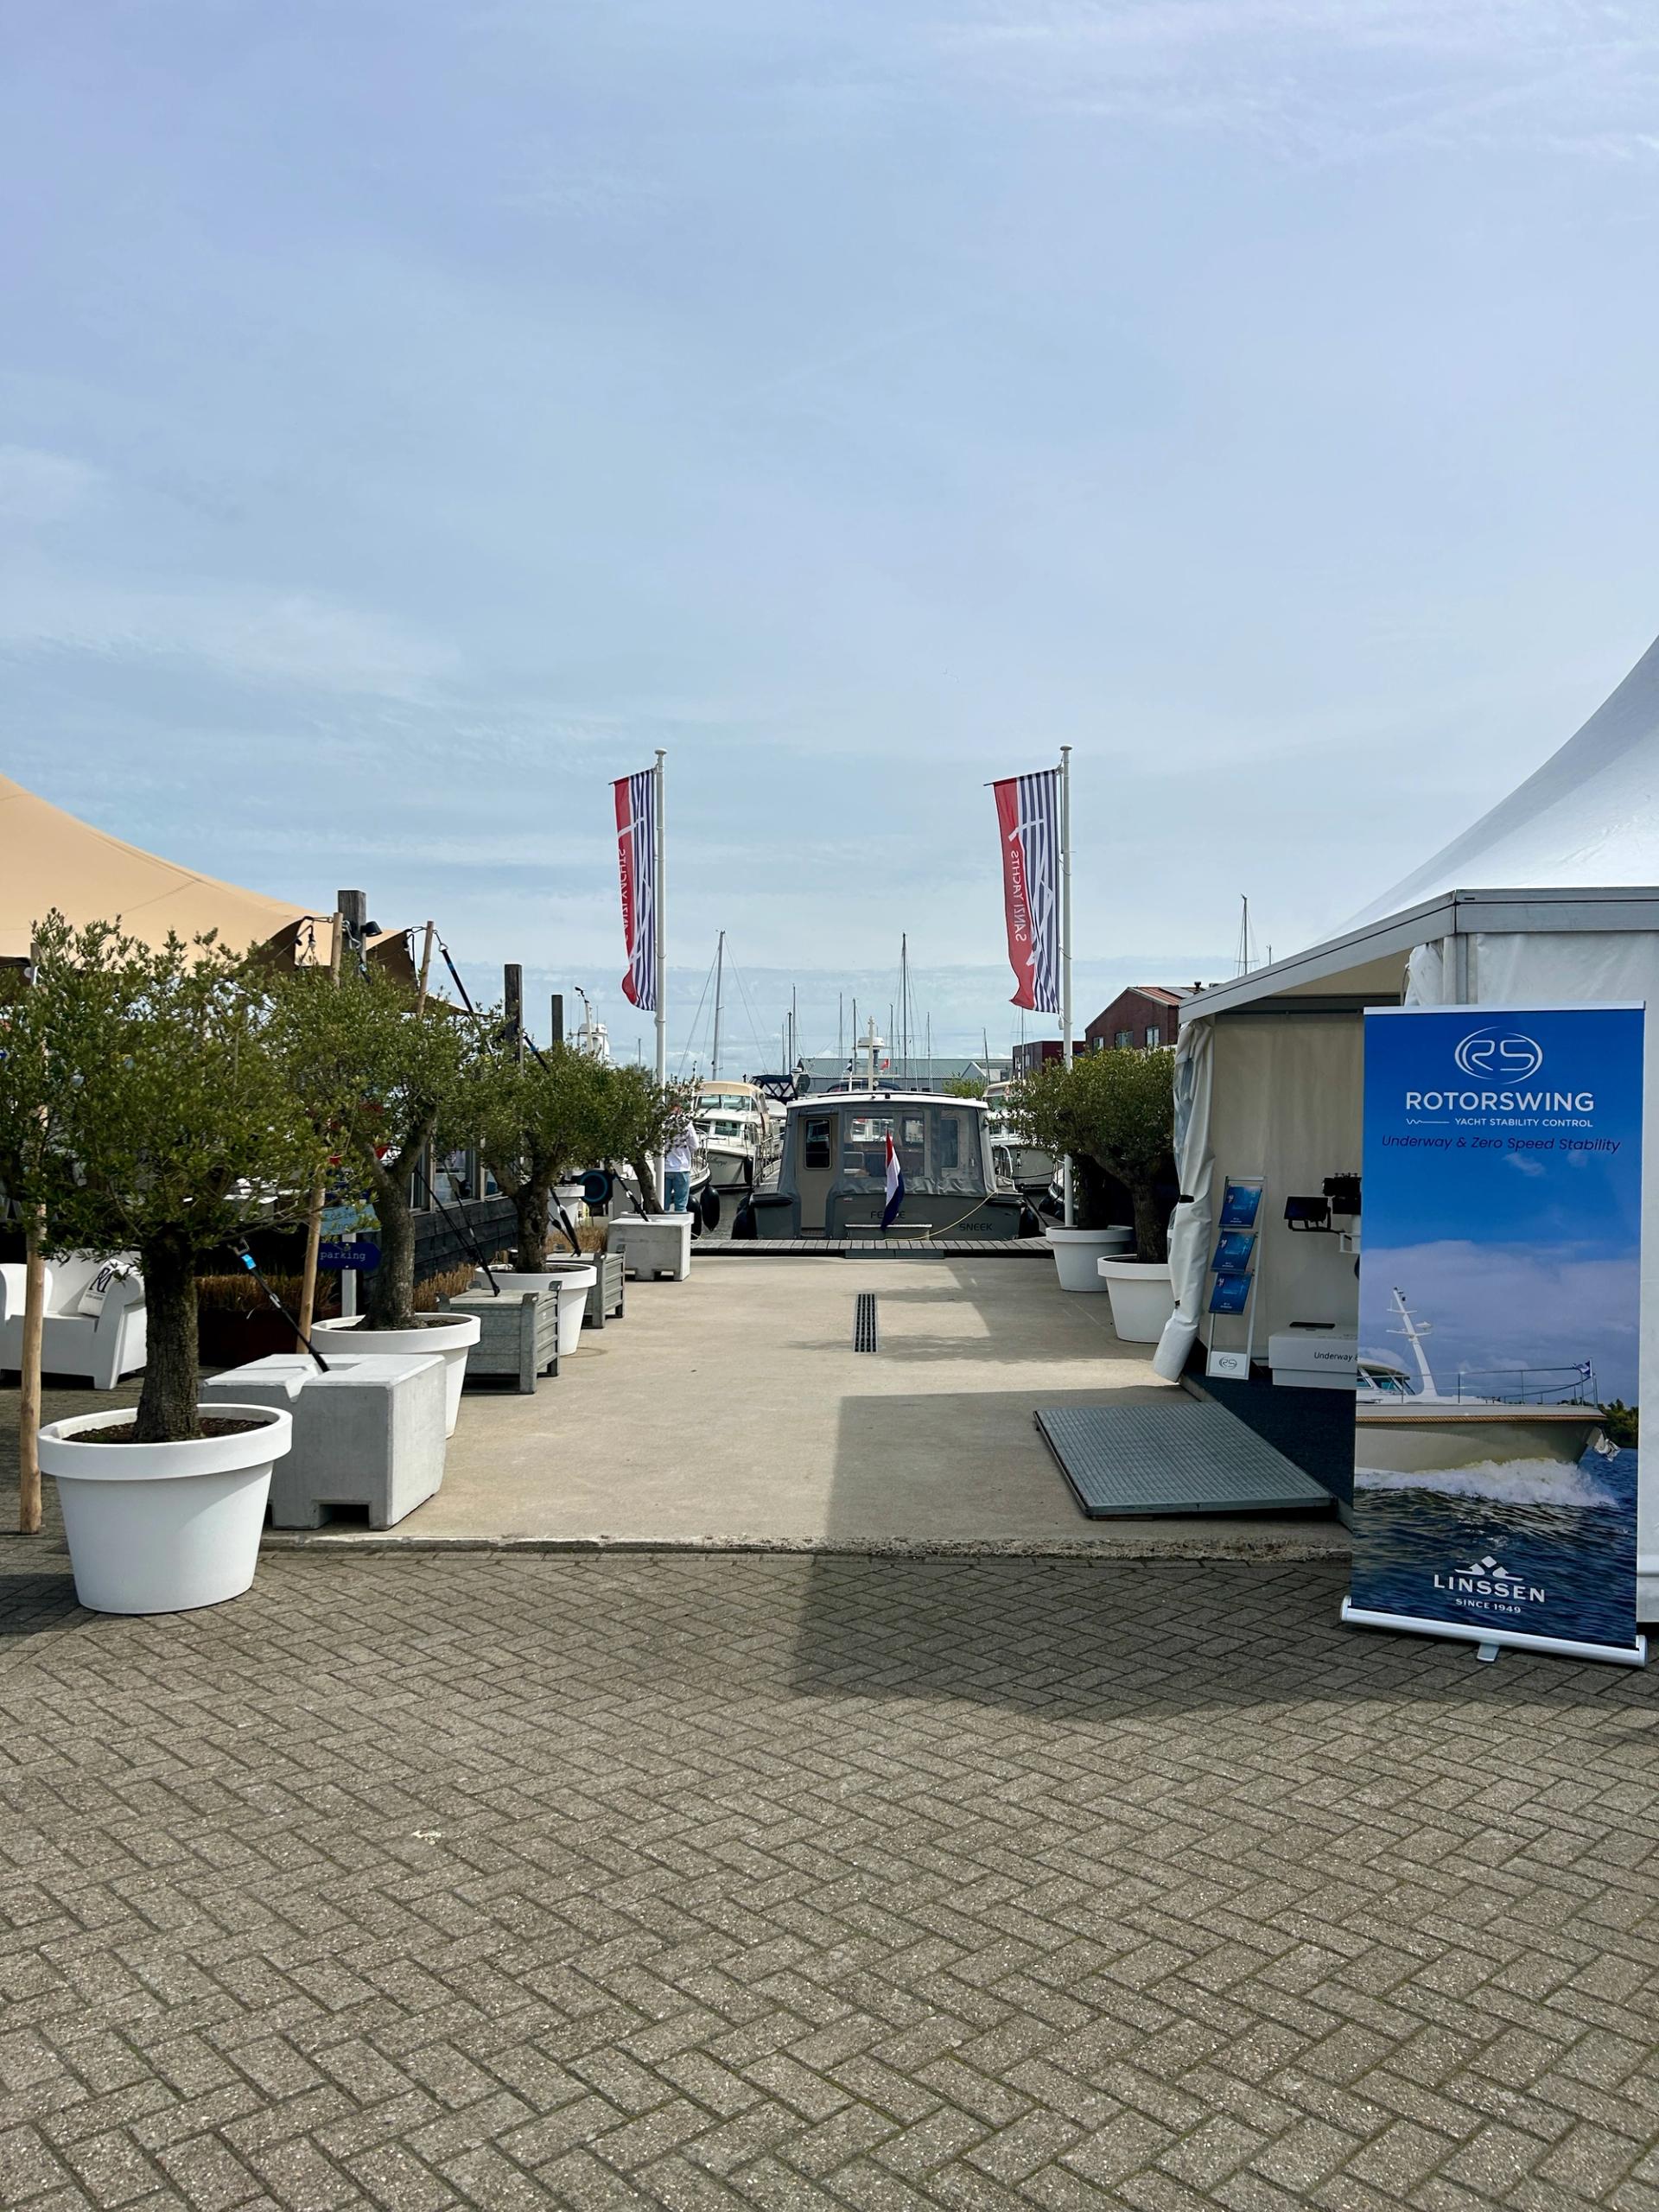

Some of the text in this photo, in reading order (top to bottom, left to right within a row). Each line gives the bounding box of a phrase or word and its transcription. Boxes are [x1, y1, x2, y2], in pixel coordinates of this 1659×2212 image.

[1406, 1091, 1594, 1112] ROTORSWING
[1454, 1117, 1593, 1128] YACHT STABILITY CONTROL
[1382, 1135, 1621, 1154] Underway & Zero Speed Stability
[320, 1251, 365, 1262] parking
[1313, 1351, 1352, 1363] Underway
[1433, 1574, 1545, 1603] LINSSEN
[1455, 1598, 1522, 1614] SINCE 1949
